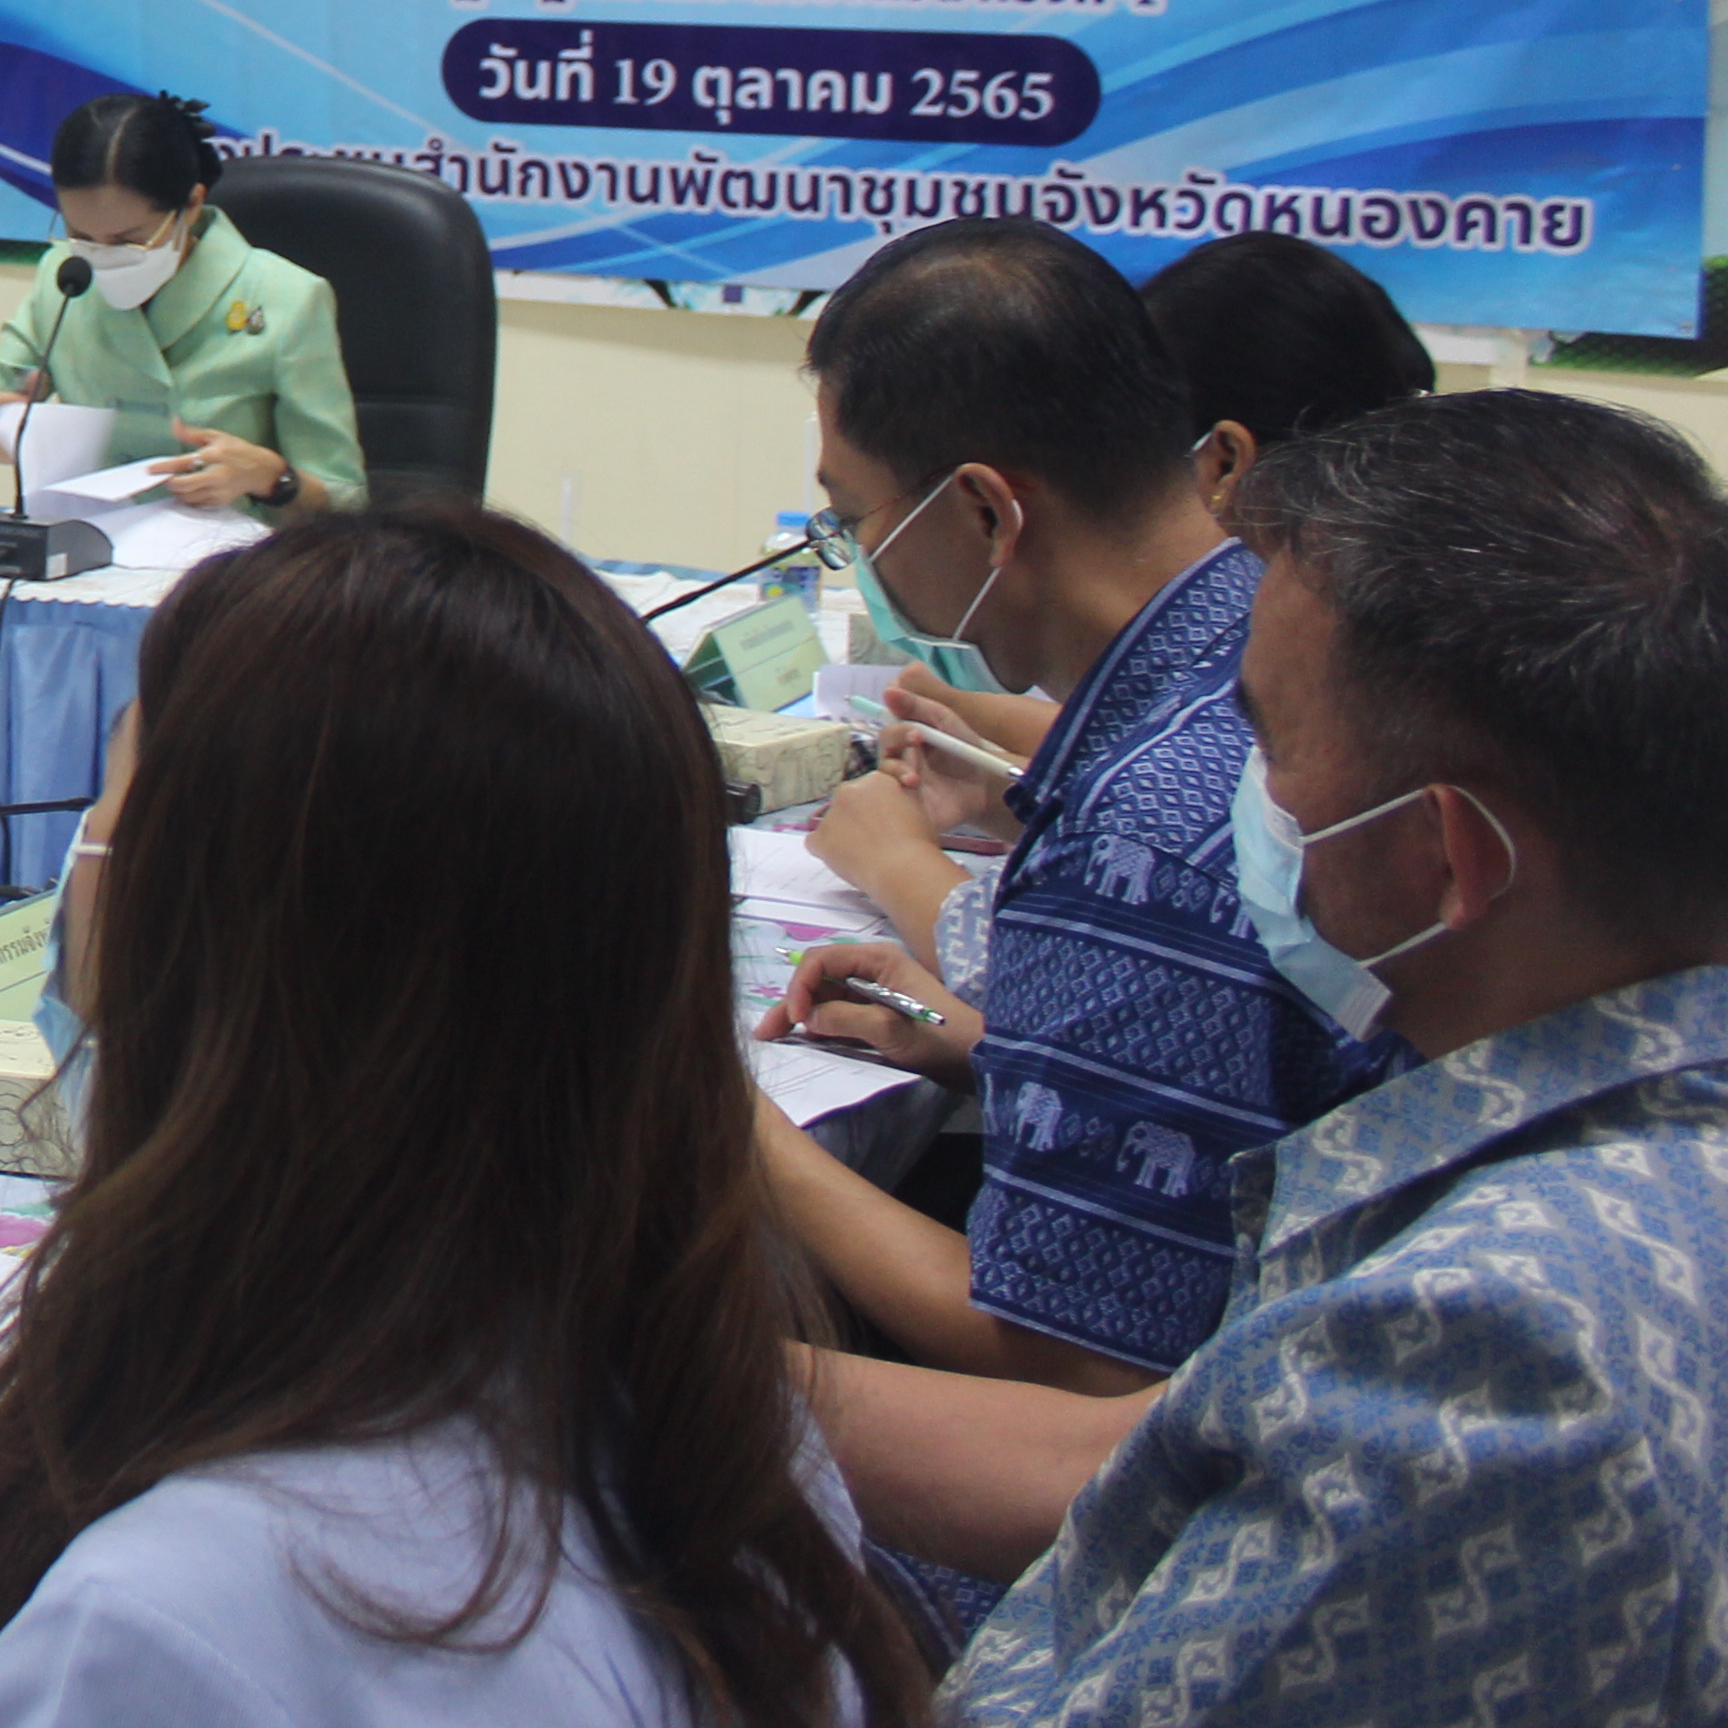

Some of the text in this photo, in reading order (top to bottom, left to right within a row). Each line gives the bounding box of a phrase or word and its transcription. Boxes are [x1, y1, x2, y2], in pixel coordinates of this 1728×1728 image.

[479, 31, 1055, 126] วันที่ 19 ตุลาคม 2565
